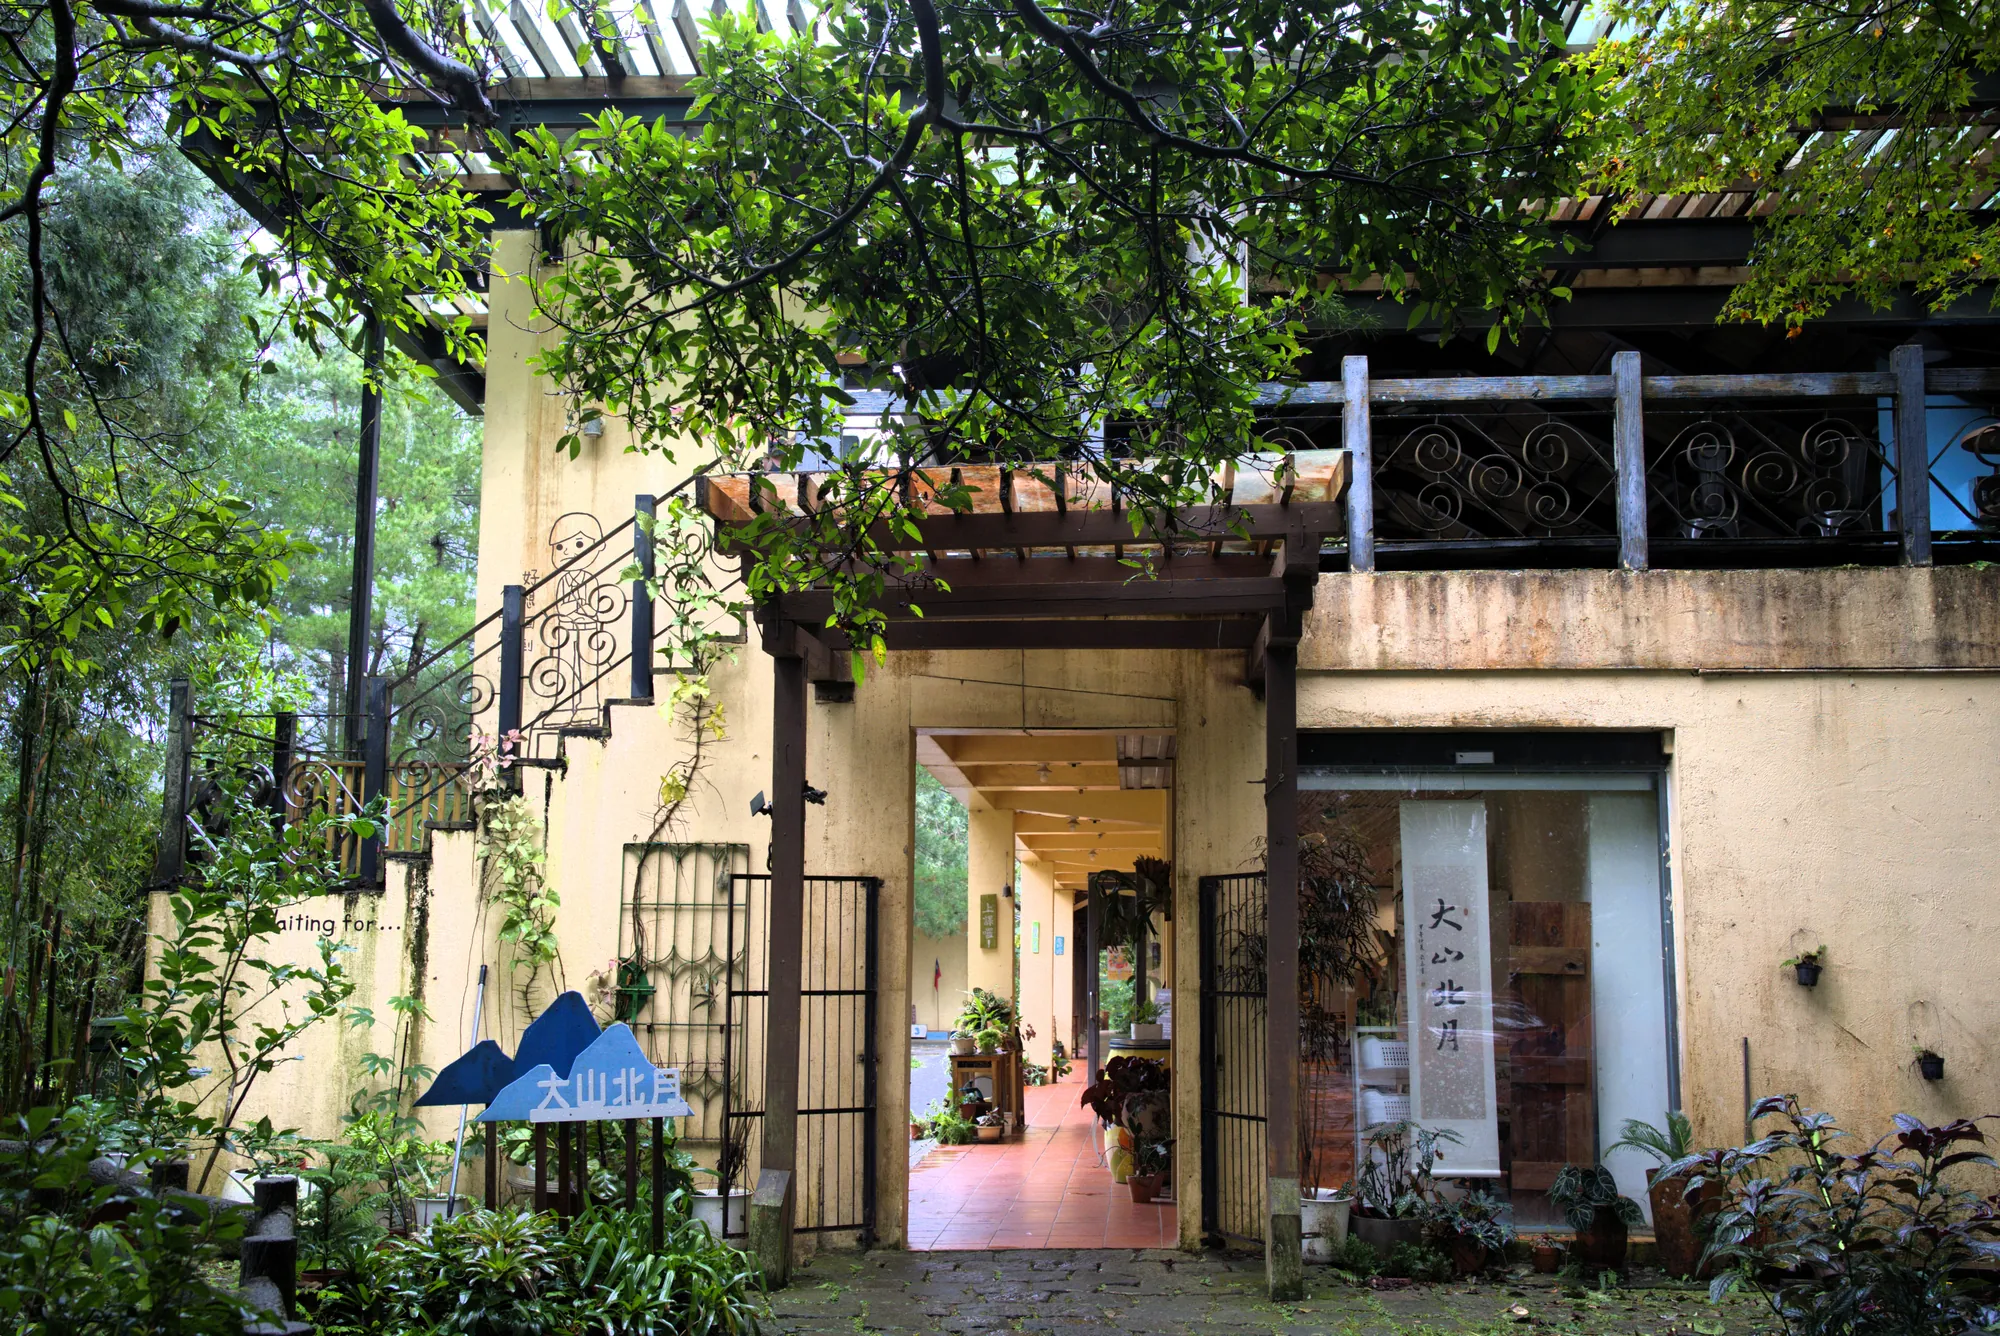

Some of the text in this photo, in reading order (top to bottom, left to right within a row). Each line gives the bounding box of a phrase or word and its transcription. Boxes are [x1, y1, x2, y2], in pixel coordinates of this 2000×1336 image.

[274, 909, 335, 936] aiting
[1428, 898, 1466, 1051] 大山北月
[536, 1067, 680, 1110] 大山北月
